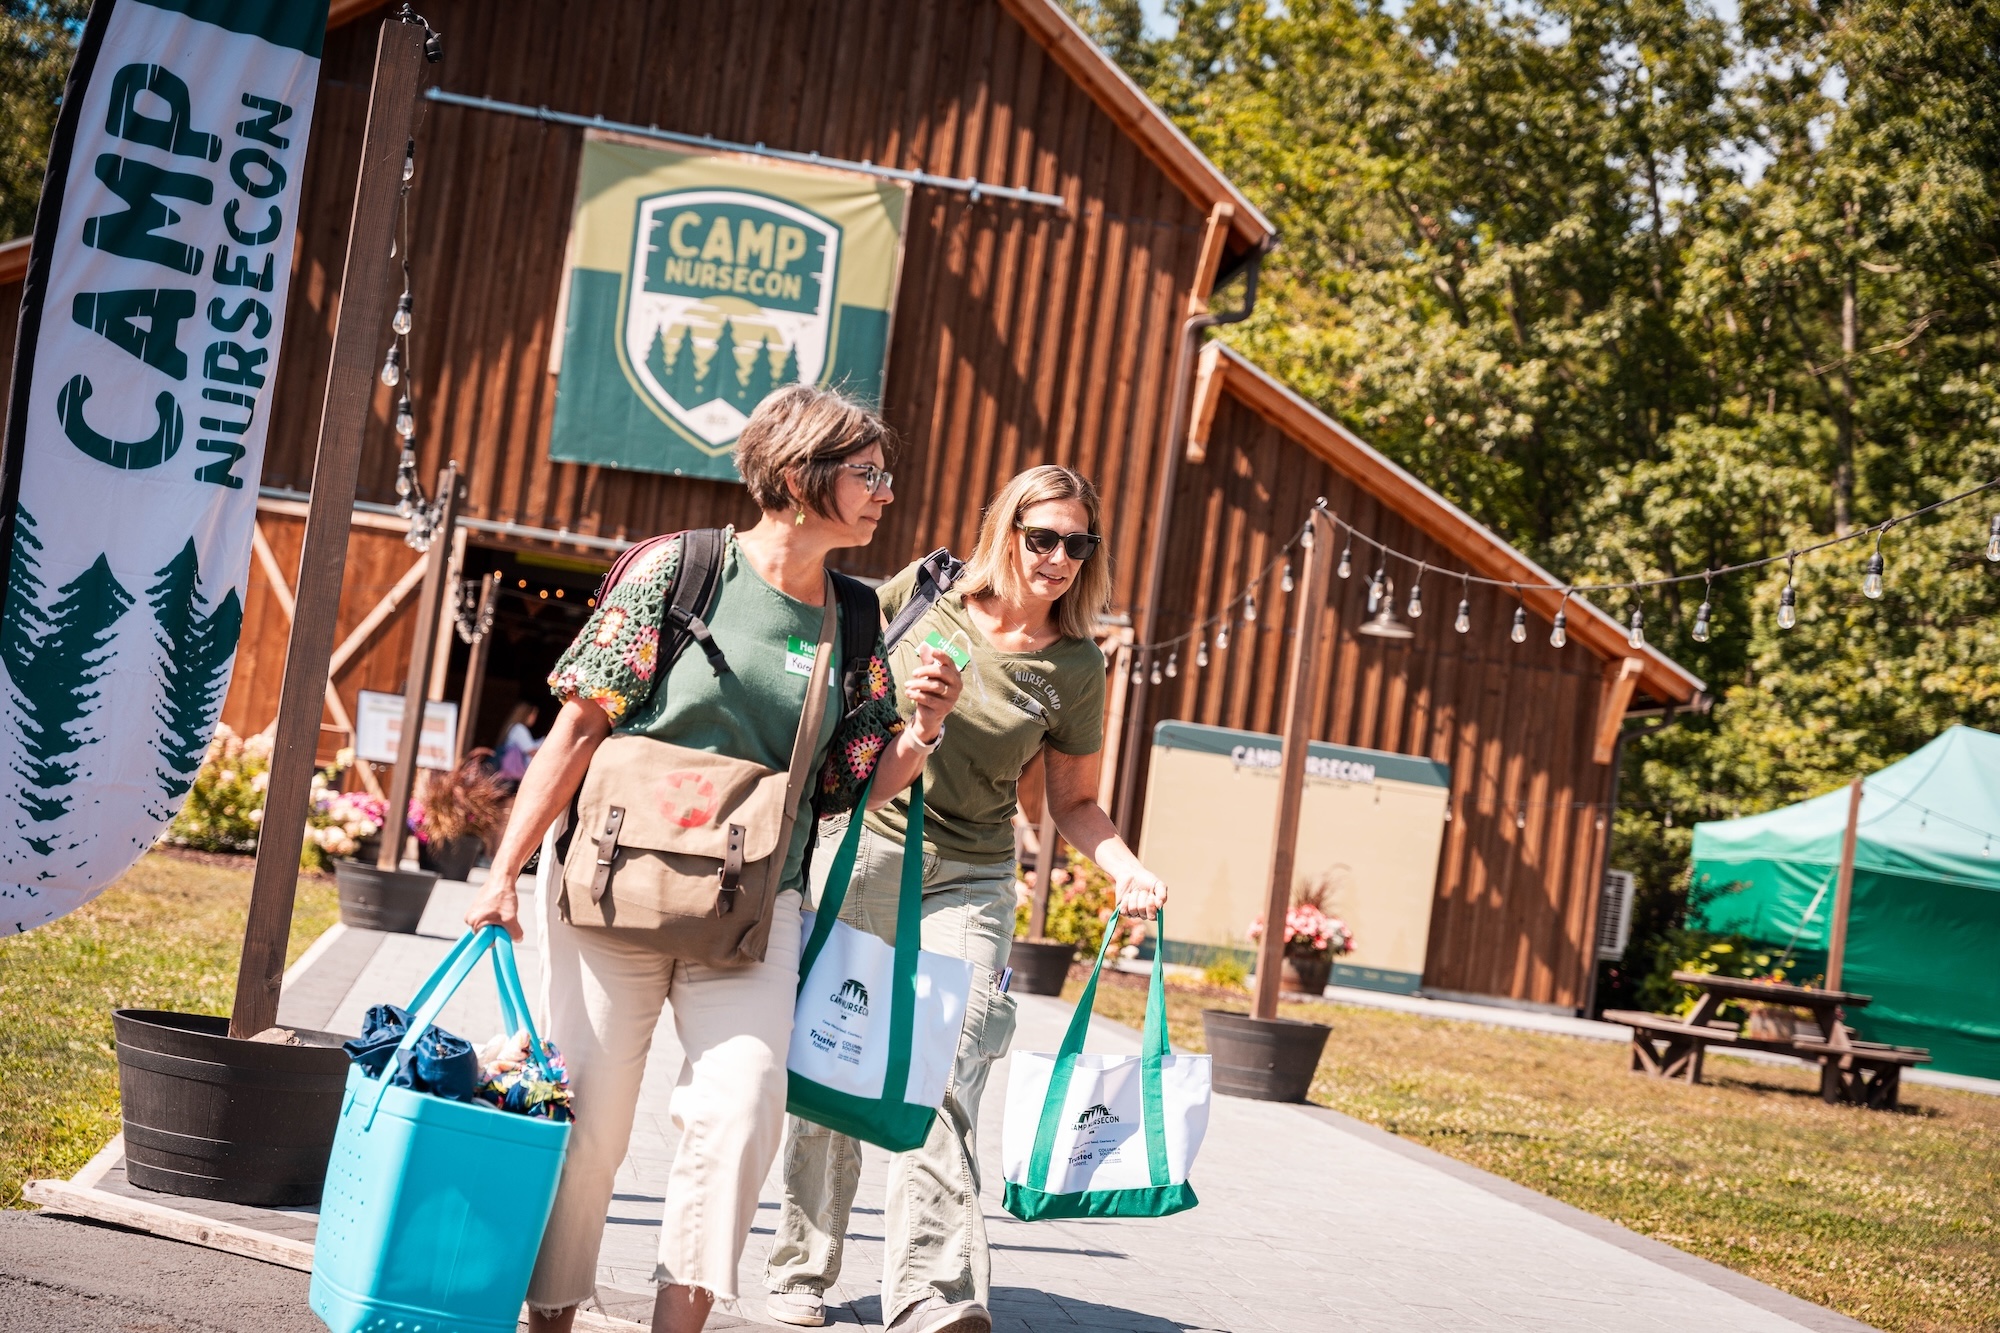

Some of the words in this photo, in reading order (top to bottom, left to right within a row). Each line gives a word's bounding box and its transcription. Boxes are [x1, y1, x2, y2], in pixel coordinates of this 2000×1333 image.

[669, 211, 808, 271] CAMP
[57, 63, 222, 470] CAMP
[664, 256, 803, 300] NURSECON
[194, 92, 295, 490] NURSECON
[1015, 671, 1047, 688] NURSE
[1043, 683, 1061, 711] CAMP
[1230, 744, 1283, 769] CAMP
[1304, 755, 1376, 785] RSECON
[810, 1028, 837, 1049] Trusted
[1071, 1123, 1087, 1131] AMP
[1068, 1152, 1093, 1164] Trusted
